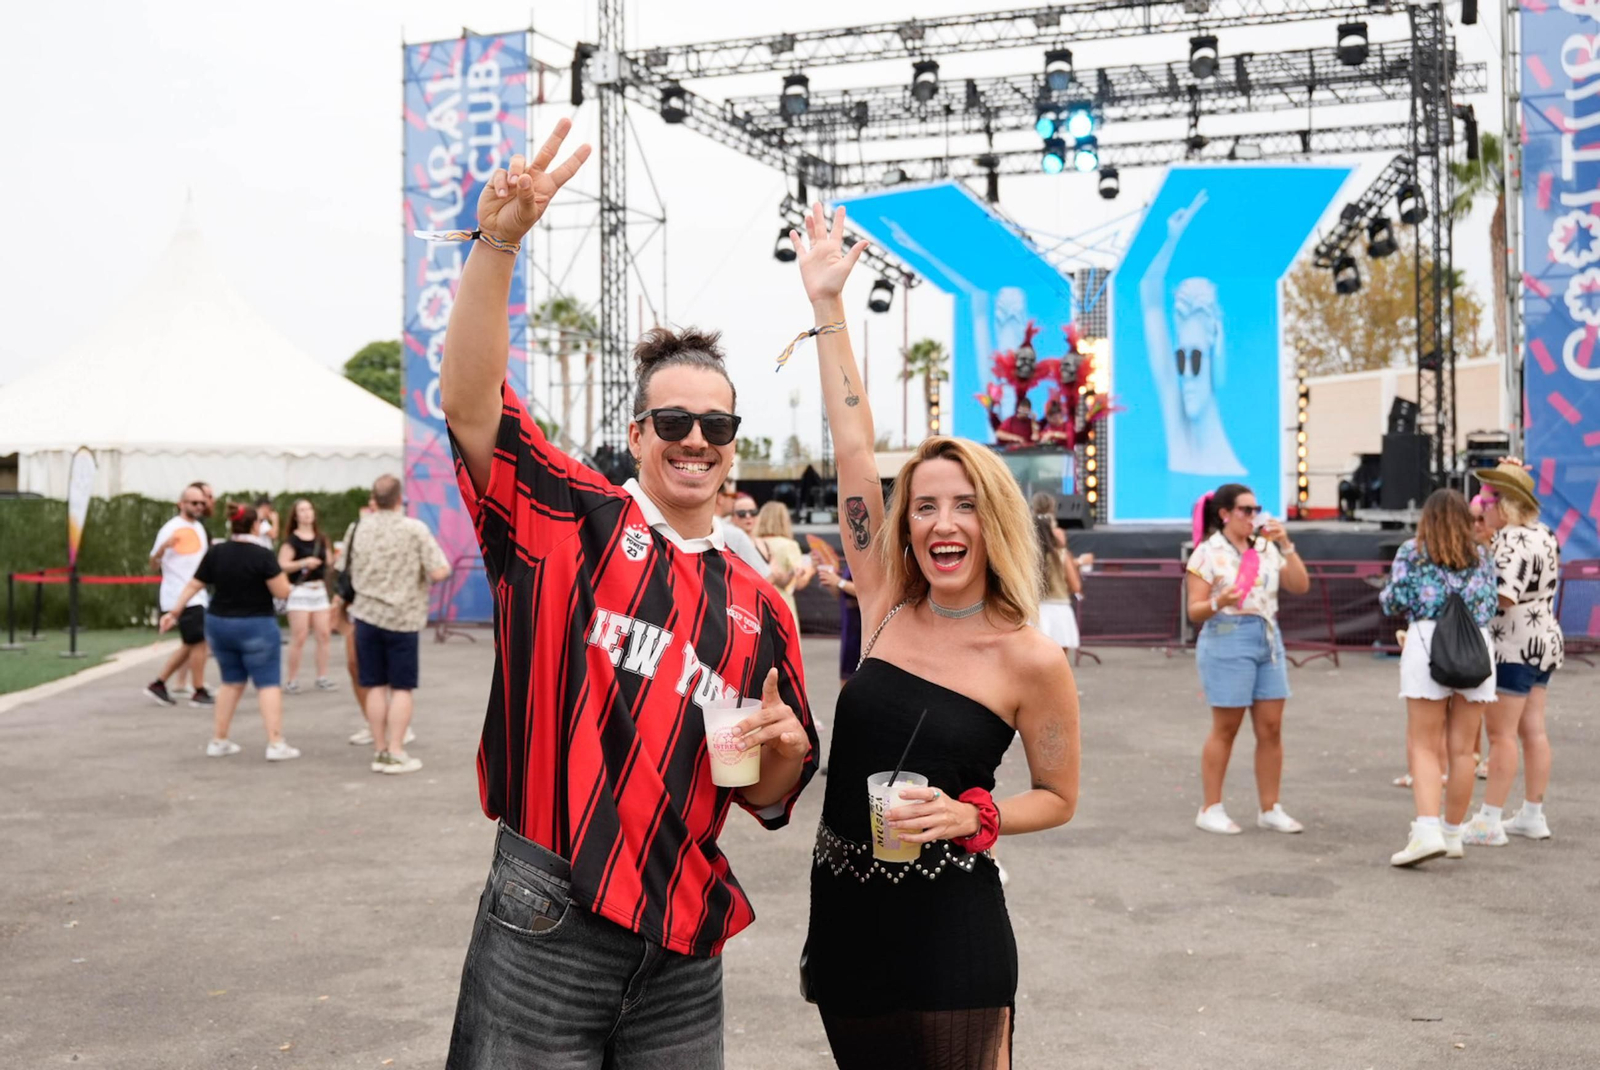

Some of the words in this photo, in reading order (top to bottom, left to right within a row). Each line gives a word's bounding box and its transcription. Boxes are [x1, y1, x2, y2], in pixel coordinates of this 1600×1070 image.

[467, 59, 501, 182] CLUB
[626, 537, 645, 552] POWER
[626, 545, 638, 558] 23
